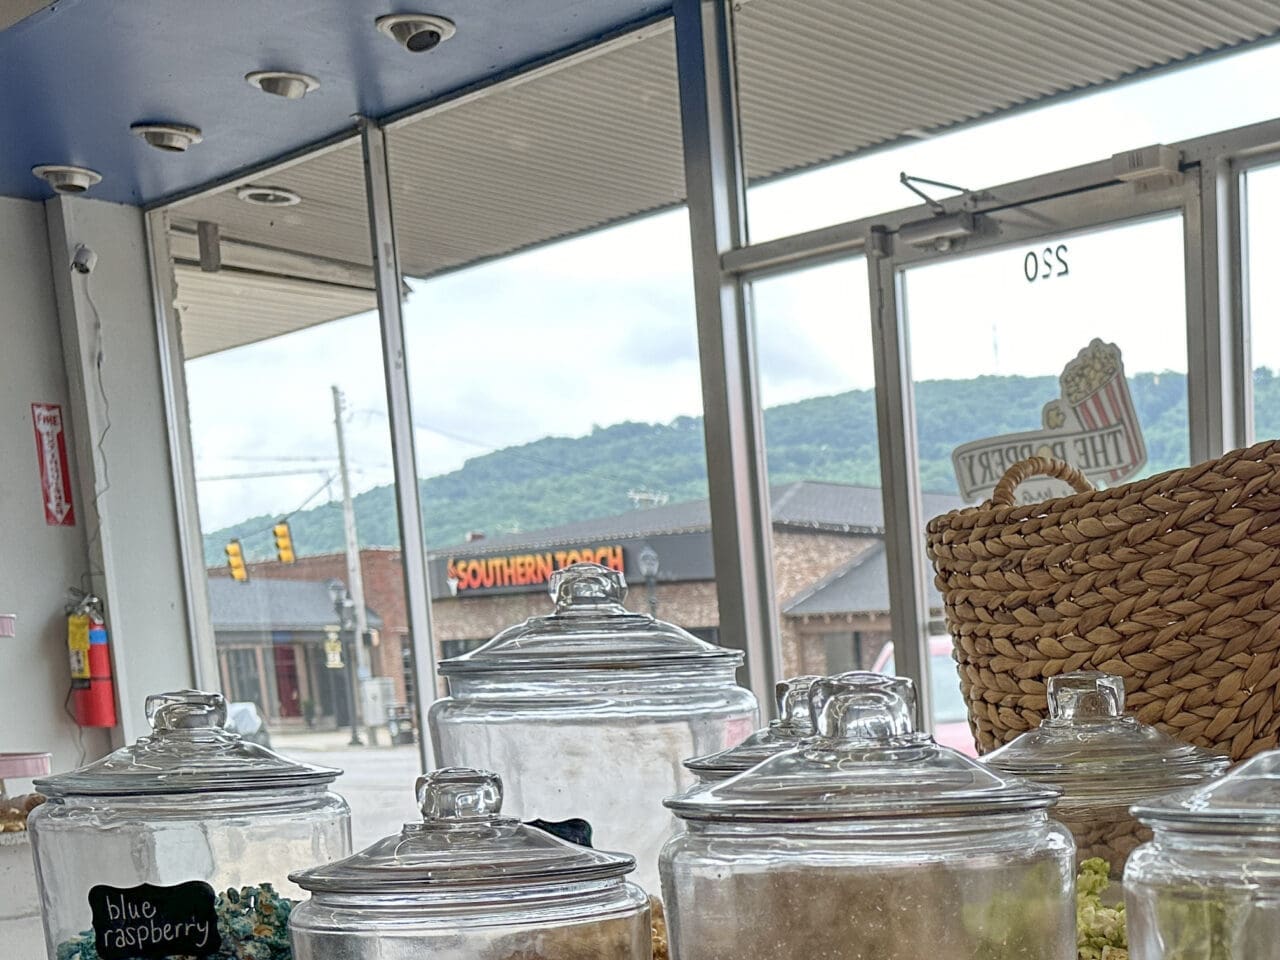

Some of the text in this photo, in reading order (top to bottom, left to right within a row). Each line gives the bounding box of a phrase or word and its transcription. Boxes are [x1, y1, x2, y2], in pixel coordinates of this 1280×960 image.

[457, 552, 554, 590] SOUTHERN
[105, 893, 157, 921] blue
[103, 917, 210, 950] raspberry
